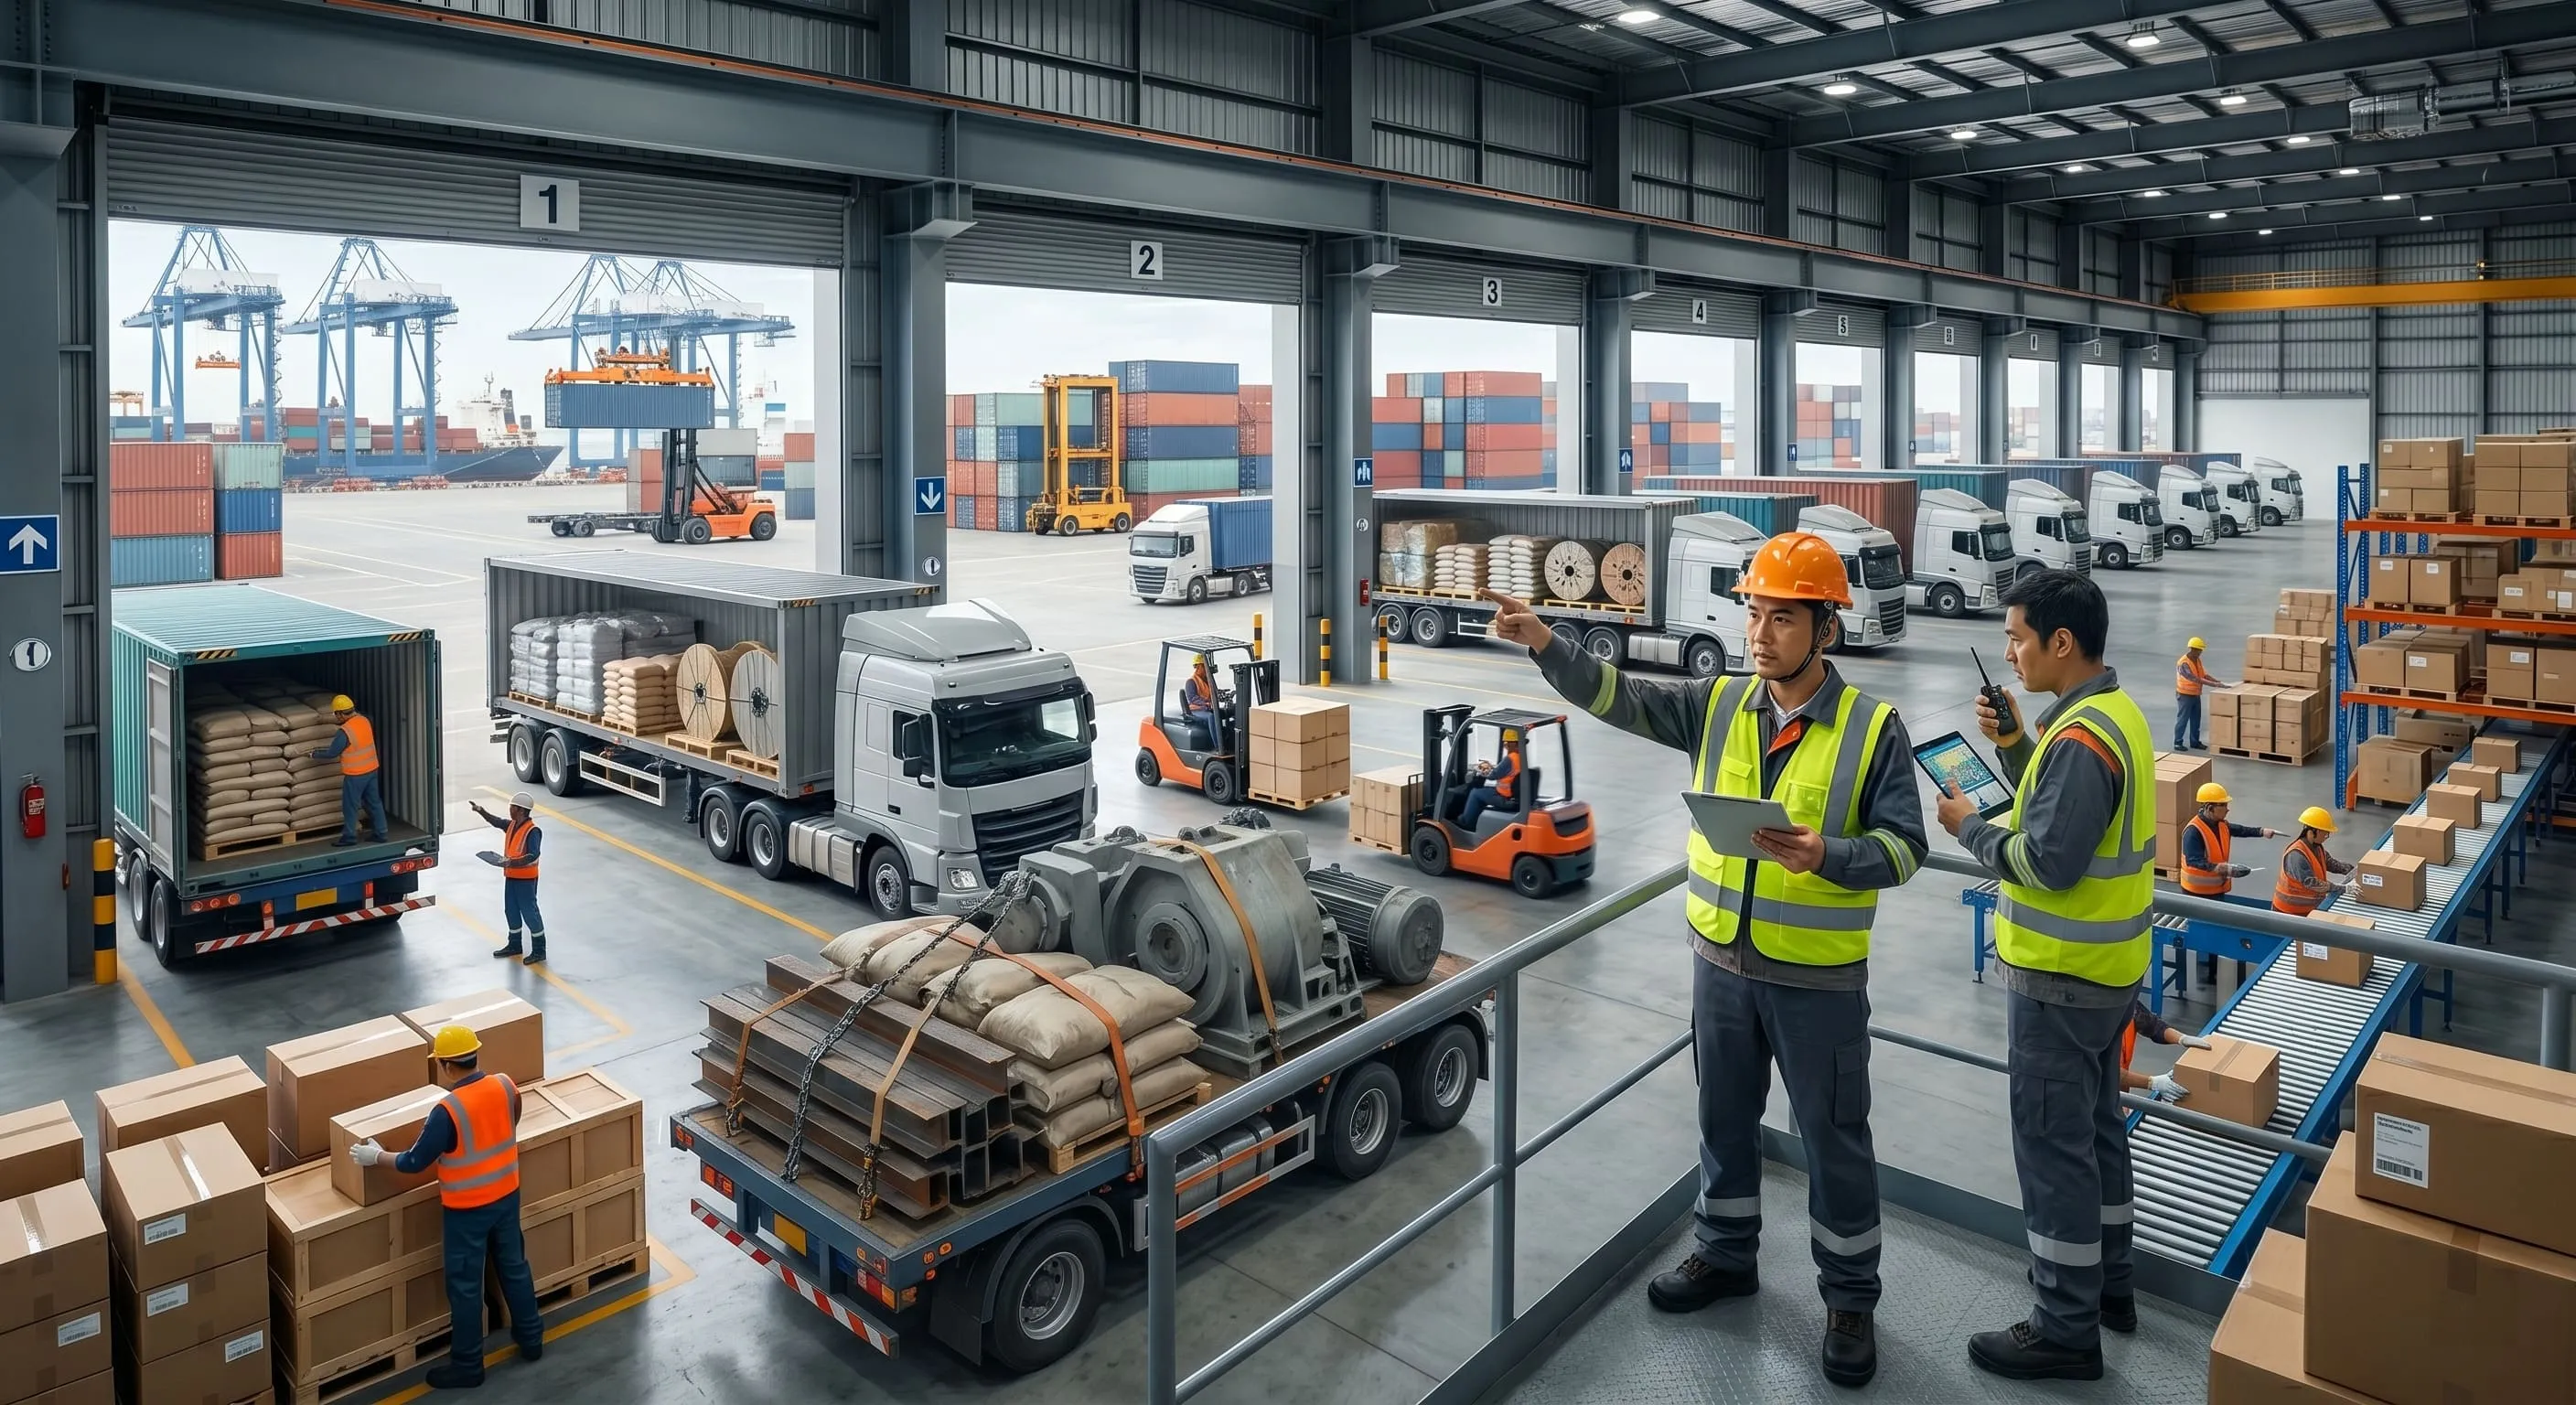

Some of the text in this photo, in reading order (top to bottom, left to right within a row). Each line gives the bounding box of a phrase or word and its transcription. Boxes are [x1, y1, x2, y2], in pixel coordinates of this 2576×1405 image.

[538, 184, 557, 224] 1
[1138, 244, 1155, 275] 2
[1487, 280, 1498, 304] 3
[1696, 302, 1704, 321] 4
